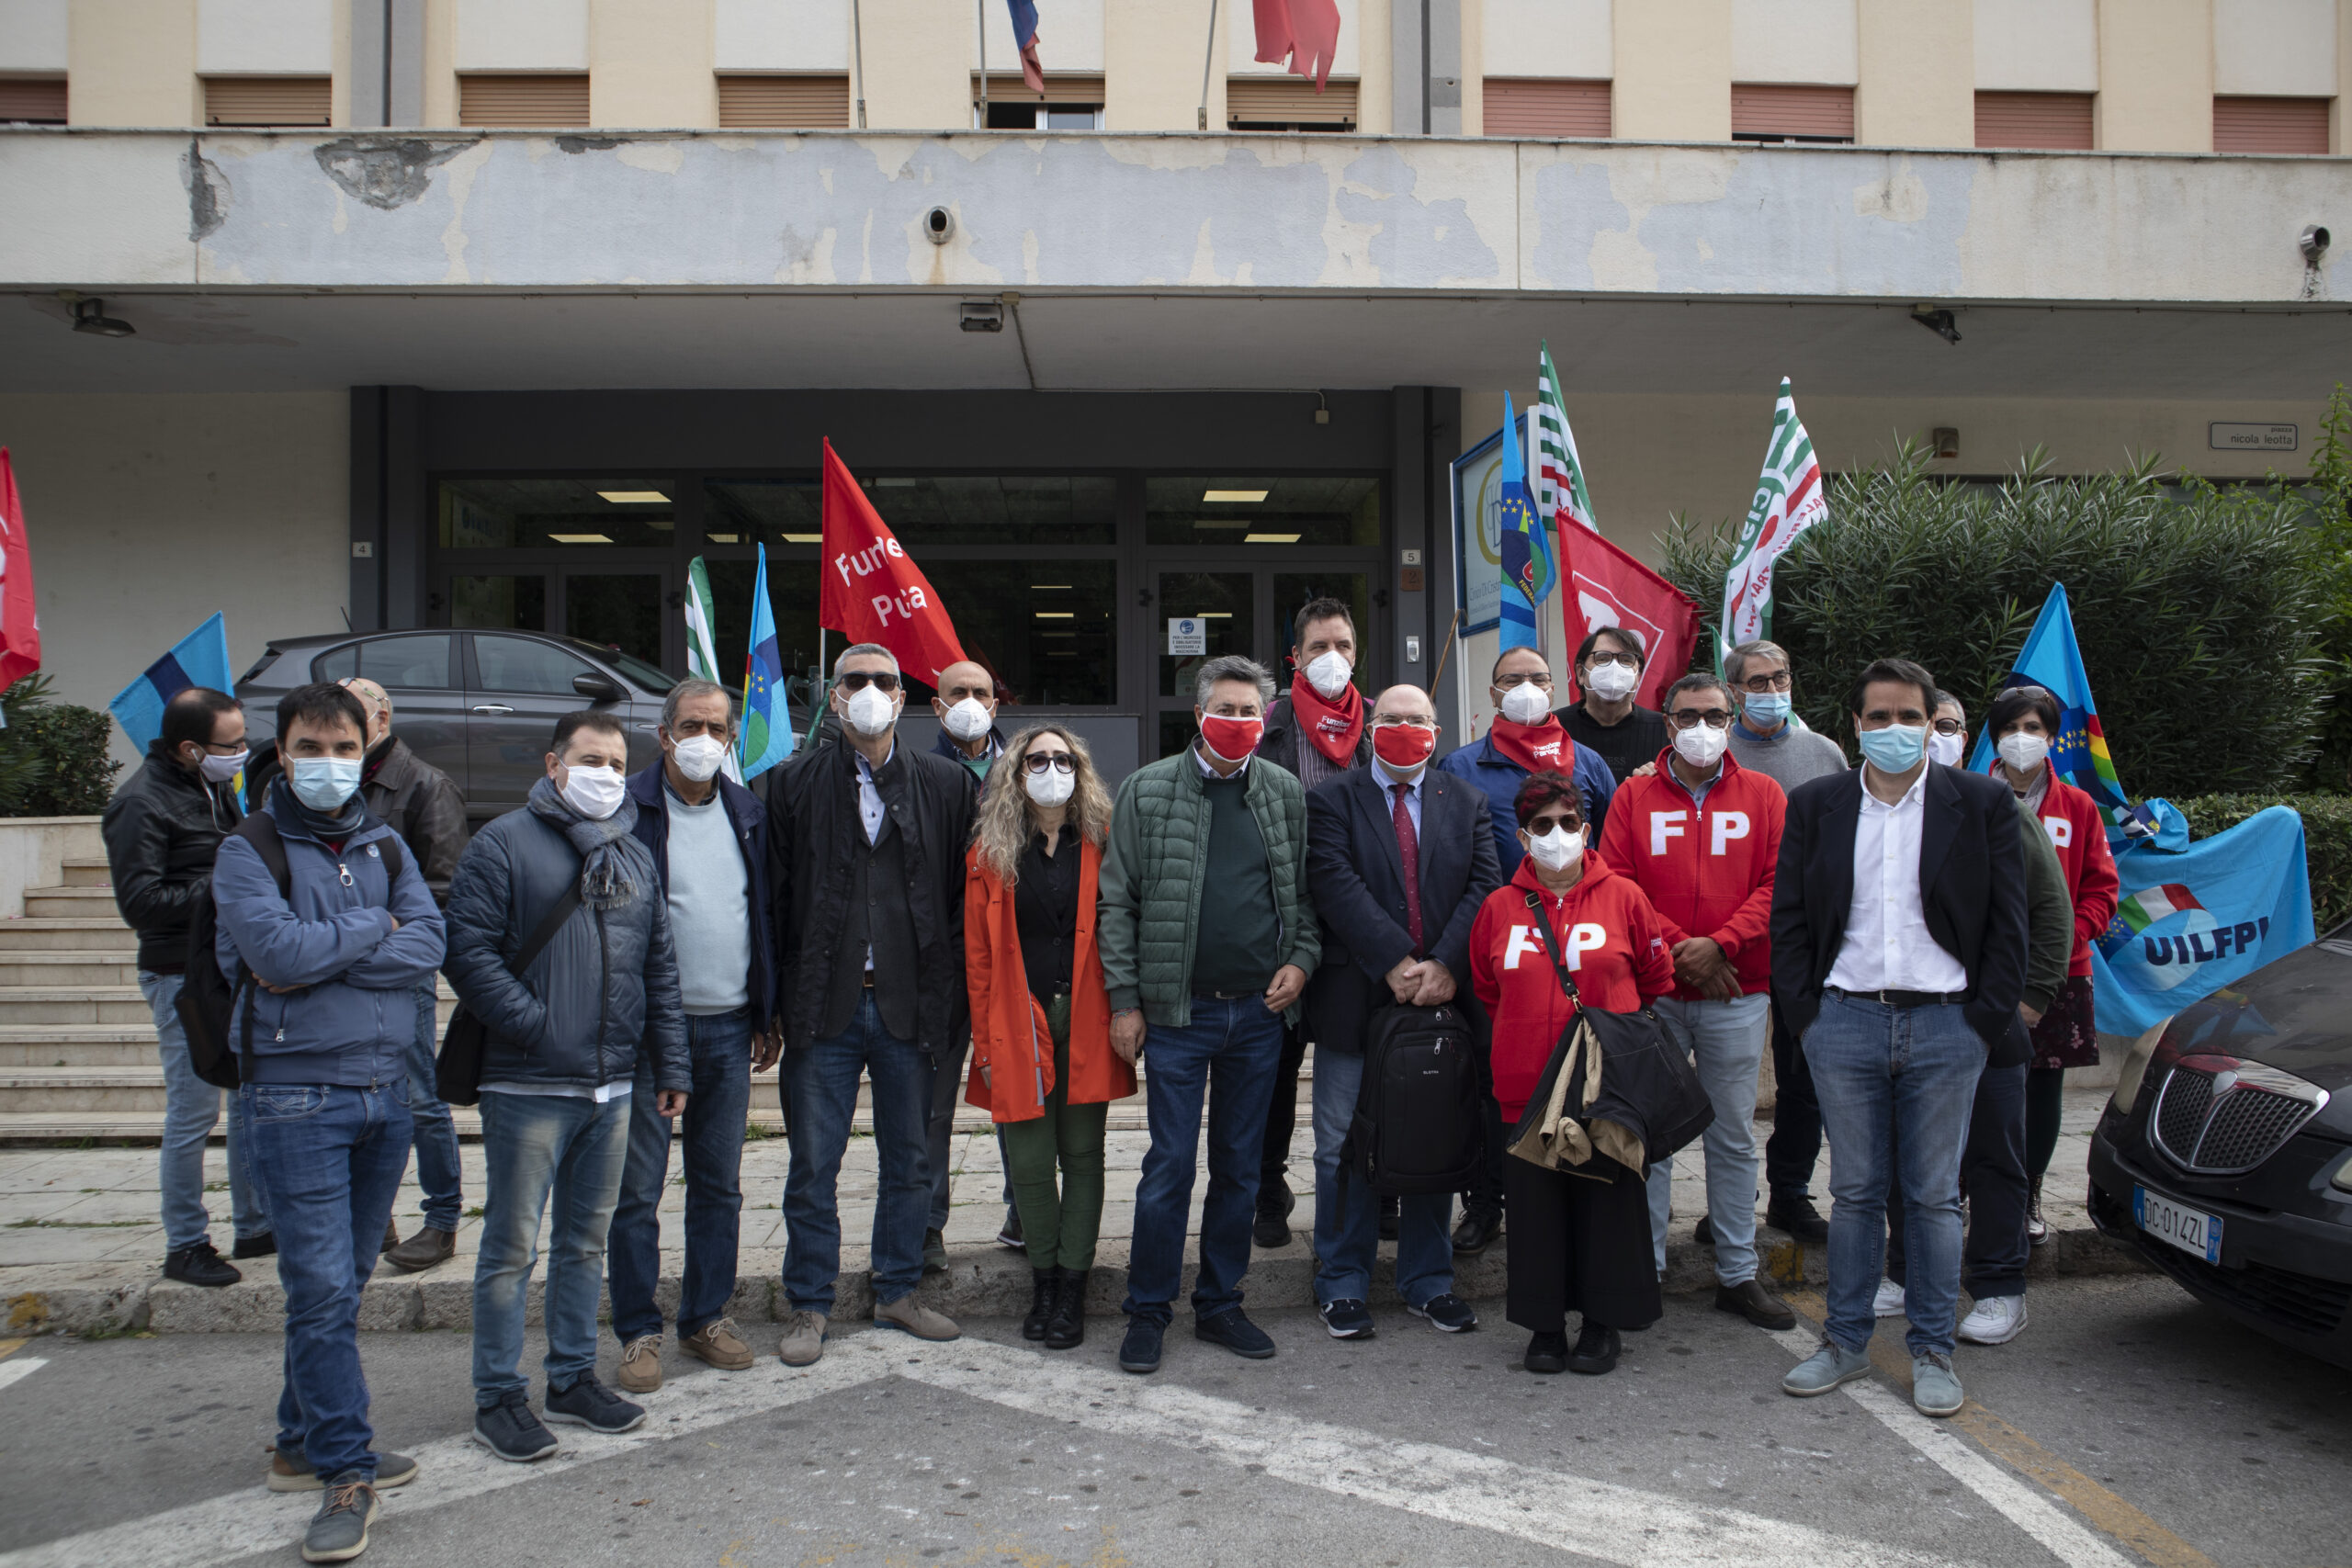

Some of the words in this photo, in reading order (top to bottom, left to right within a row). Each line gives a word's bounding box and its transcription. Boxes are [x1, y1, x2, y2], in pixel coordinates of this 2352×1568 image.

[2231, 434, 2259, 444] nicola
[2264, 434, 2292, 445] leotta
[358, 545, 367, 553] 4
[1408, 552, 1415, 562] 5
